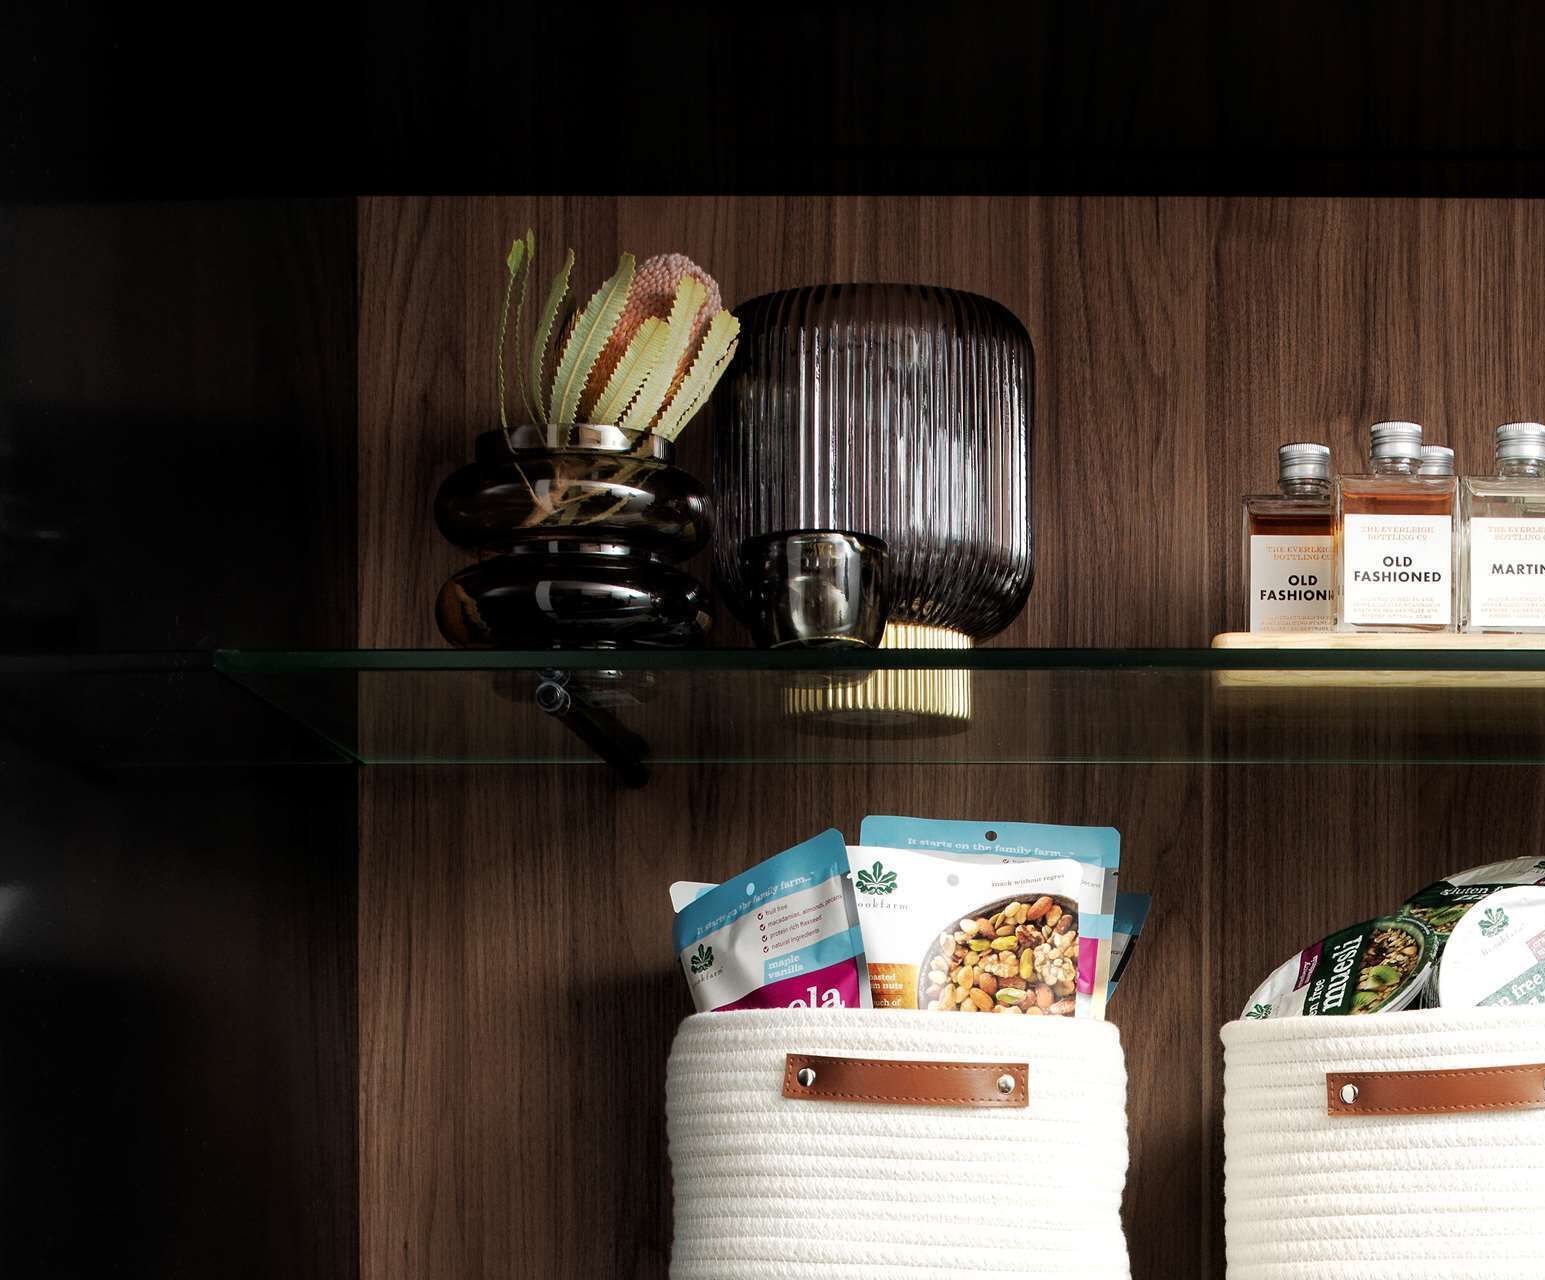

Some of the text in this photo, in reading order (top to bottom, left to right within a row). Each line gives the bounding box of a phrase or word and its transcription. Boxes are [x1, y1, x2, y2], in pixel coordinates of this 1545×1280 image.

[1383, 556, 1412, 568] OLD
[1288, 574, 1318, 586] OLD
[1354, 571, 1442, 582] FASHIONED
[918, 839, 952, 848] starts
[954, 842, 970, 850] on
[972, 842, 992, 850] the
[995, 844, 1031, 856] family
[1440, 886, 1488, 896] gluten
[768, 955, 800, 969] maple
[768, 964, 804, 979] vanilla
[1322, 934, 1363, 1012] muesli
[883, 982, 904, 990] nuts
[1512, 973, 1544, 998] free
